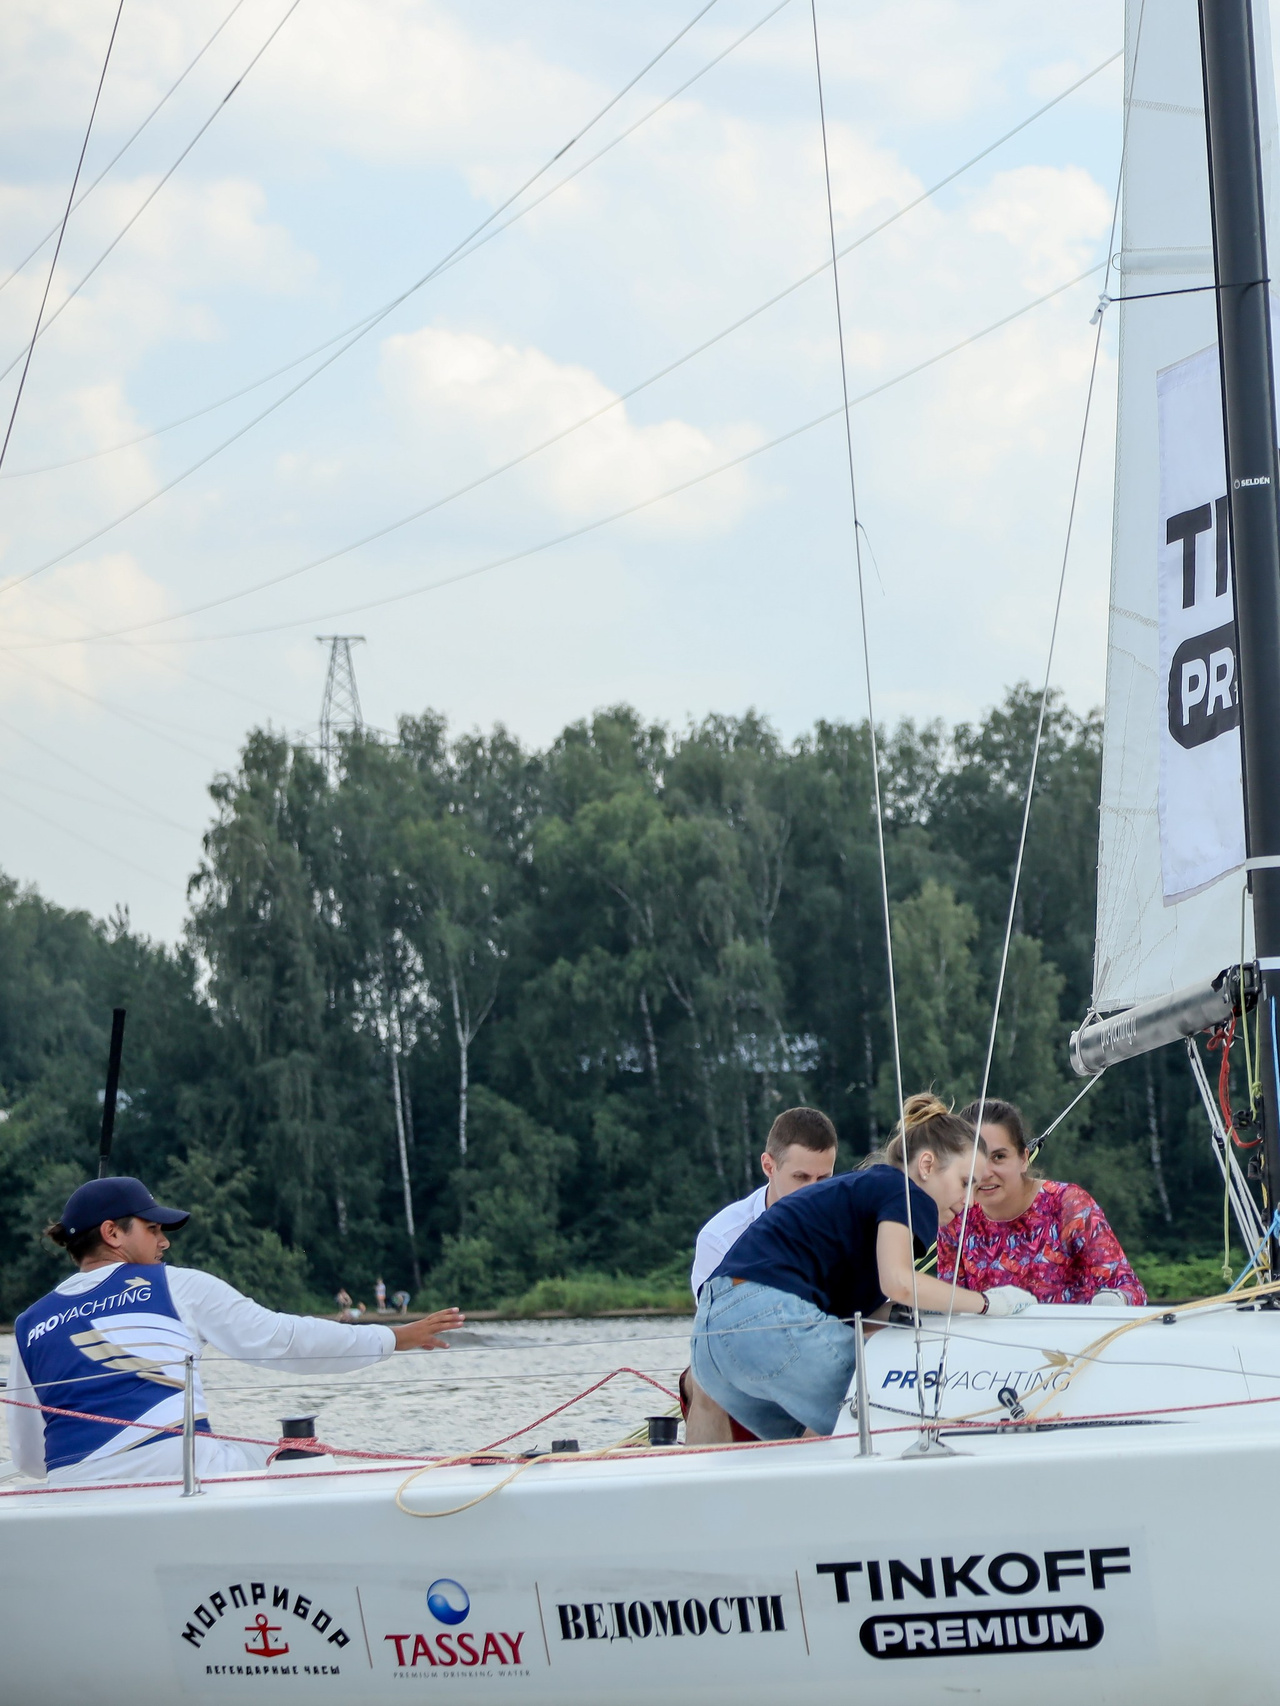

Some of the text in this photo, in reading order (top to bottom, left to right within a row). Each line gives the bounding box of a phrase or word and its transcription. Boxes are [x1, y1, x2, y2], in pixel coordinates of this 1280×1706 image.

[1241, 476, 1270, 487] SELDÉN
[1166, 494, 1229, 610] TI
[1181, 646, 1240, 727] PR
[26, 1287, 152, 1348] PROYACHTING
[881, 1369, 1072, 1392] PROYACHTING
[816, 1546, 1132, 1604] TINKOFF
[181, 1582, 351, 1649] МОРПРИБОР
[556, 1594, 788, 1644] ВЕДОМОСТИ
[873, 1612, 1089, 1652] PREMIUM
[205, 1664, 341, 1677] ЛЕГЕНДАРНЫЕ ЧАСЫ
[384, 1631, 525, 1667] TASSAY
[393, 1669, 531, 1680] PREMIUM DRINKING WATER
